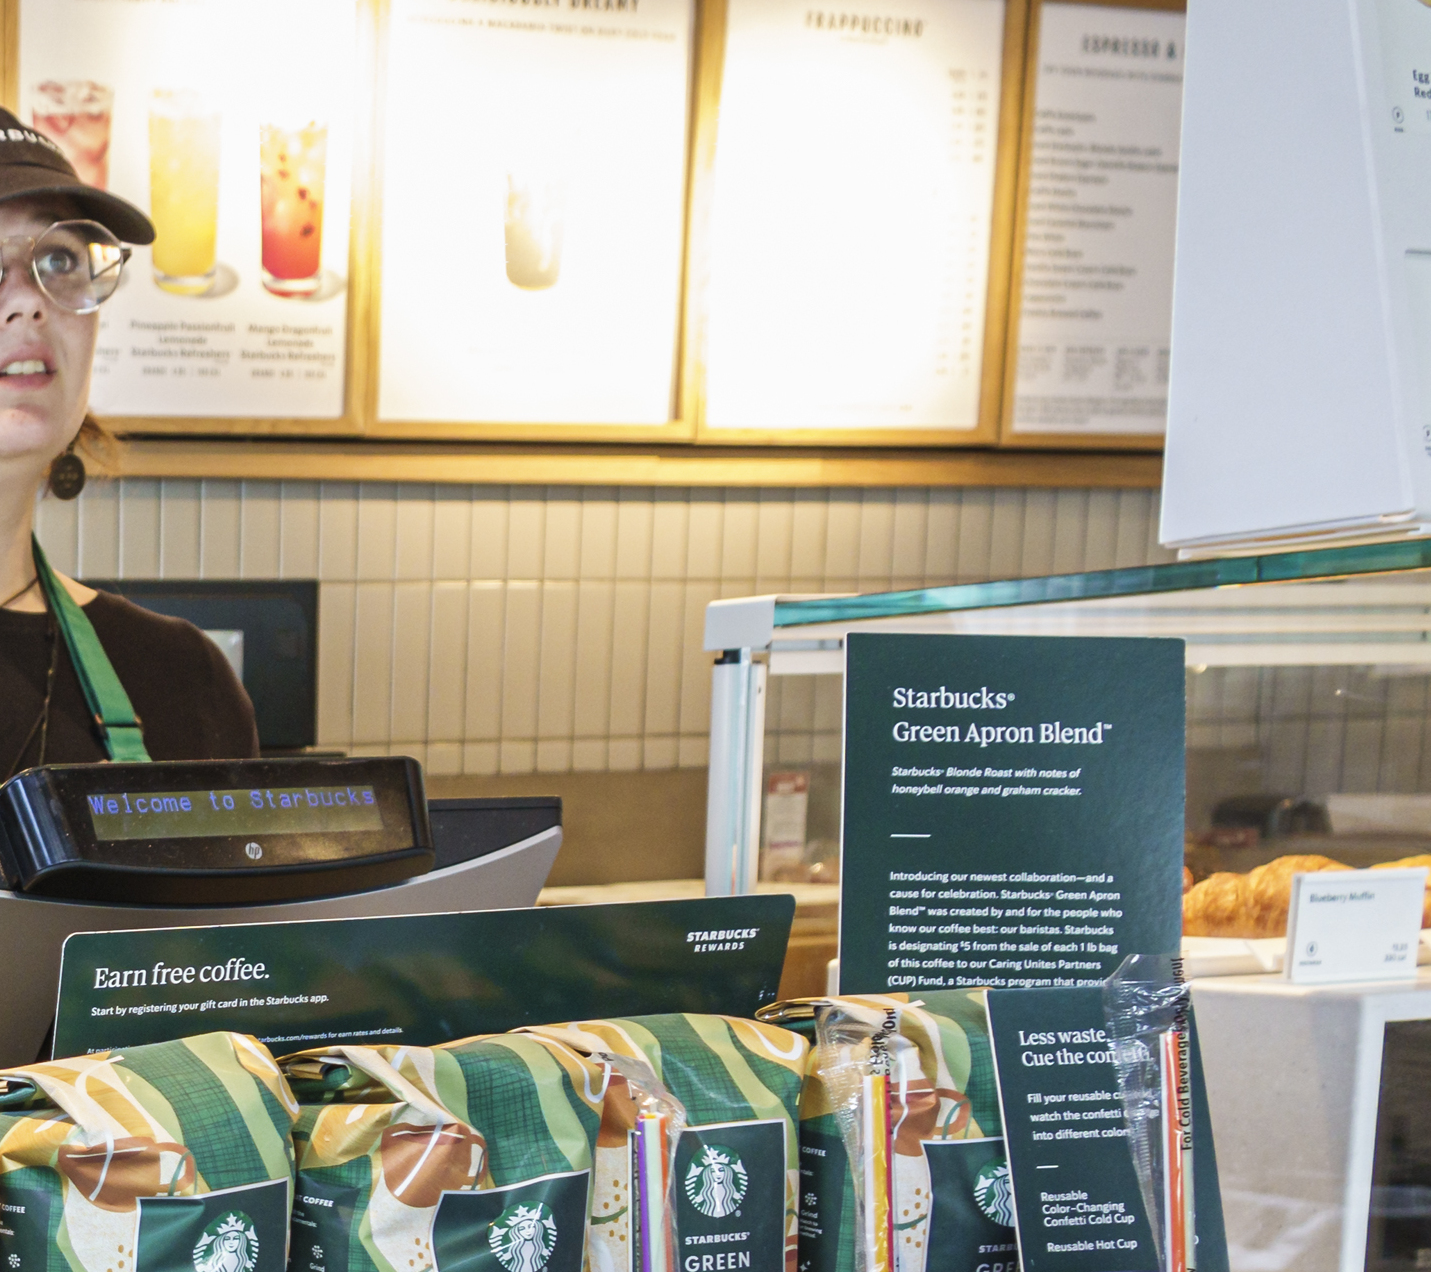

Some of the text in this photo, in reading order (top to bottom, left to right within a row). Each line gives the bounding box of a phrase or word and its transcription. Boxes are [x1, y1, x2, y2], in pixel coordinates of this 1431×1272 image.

[1082, 33, 1177, 61] ESPRESSO &
[892, 721, 960, 742] Green
[964, 722, 1035, 748] Apron
[946, 766, 1068, 779] Blonde Roast with notes
[891, 784, 1082, 798] honeybell orange graham cracker.
[87, 787, 376, 815] Welcome to Starbucks
[248, 843, 262, 859] hp
[889, 871, 1007, 883] Introducing newest
[889, 889, 1120, 903] cause celebration. Green Apron
[1310, 891, 1375, 904] Blueberry Muffin
[949, 906, 989, 917] created
[1062, 908, 1099, 920] people
[889, 923, 1115, 936] know coffee best: baristas. Starbucks
[694, 941, 745, 953] REWARDS
[898, 941, 1118, 955] designating $5 from sale each bag
[901, 959, 1101, 971] this coffee Caring Unites Partners
[93, 958, 270, 989] Earn free coffee.
[887, 976, 1075, 988] (CUP) Fund, Starbucks program that
[91, 994, 330, 1016] Start registering your gift card Starbucks app.
[382, 1027, 403, 1035] details.
[1019, 1028, 1109, 1046] Less waste.
[1021, 1048, 1084, 1067] Cue the
[1027, 1093, 1042, 1103] Fill
[1044, 1094, 1066, 1105] your
[1068, 1091, 1111, 1102] reusable
[1030, 1111, 1061, 1122] watch
[1063, 1110, 1081, 1121] the
[1082, 1109, 1122, 1120] confetti
[1177, 1100, 1192, 1151] For Cold
[1032, 1128, 1100, 1141] into different
[802, 1146, 826, 1157] COFFEE
[303, 1196, 334, 1208] COFFEE
[1041, 1190, 1088, 1202] Reusable
[1, 1203, 26, 1214] COFFEE
[1041, 1201, 1125, 1216] Color-Changing
[1043, 1213, 1135, 1227] Confetti Cold Cup
[1047, 1239, 1138, 1253] Reusable Hot Cup
[684, 1250, 751, 1272] GREEN
